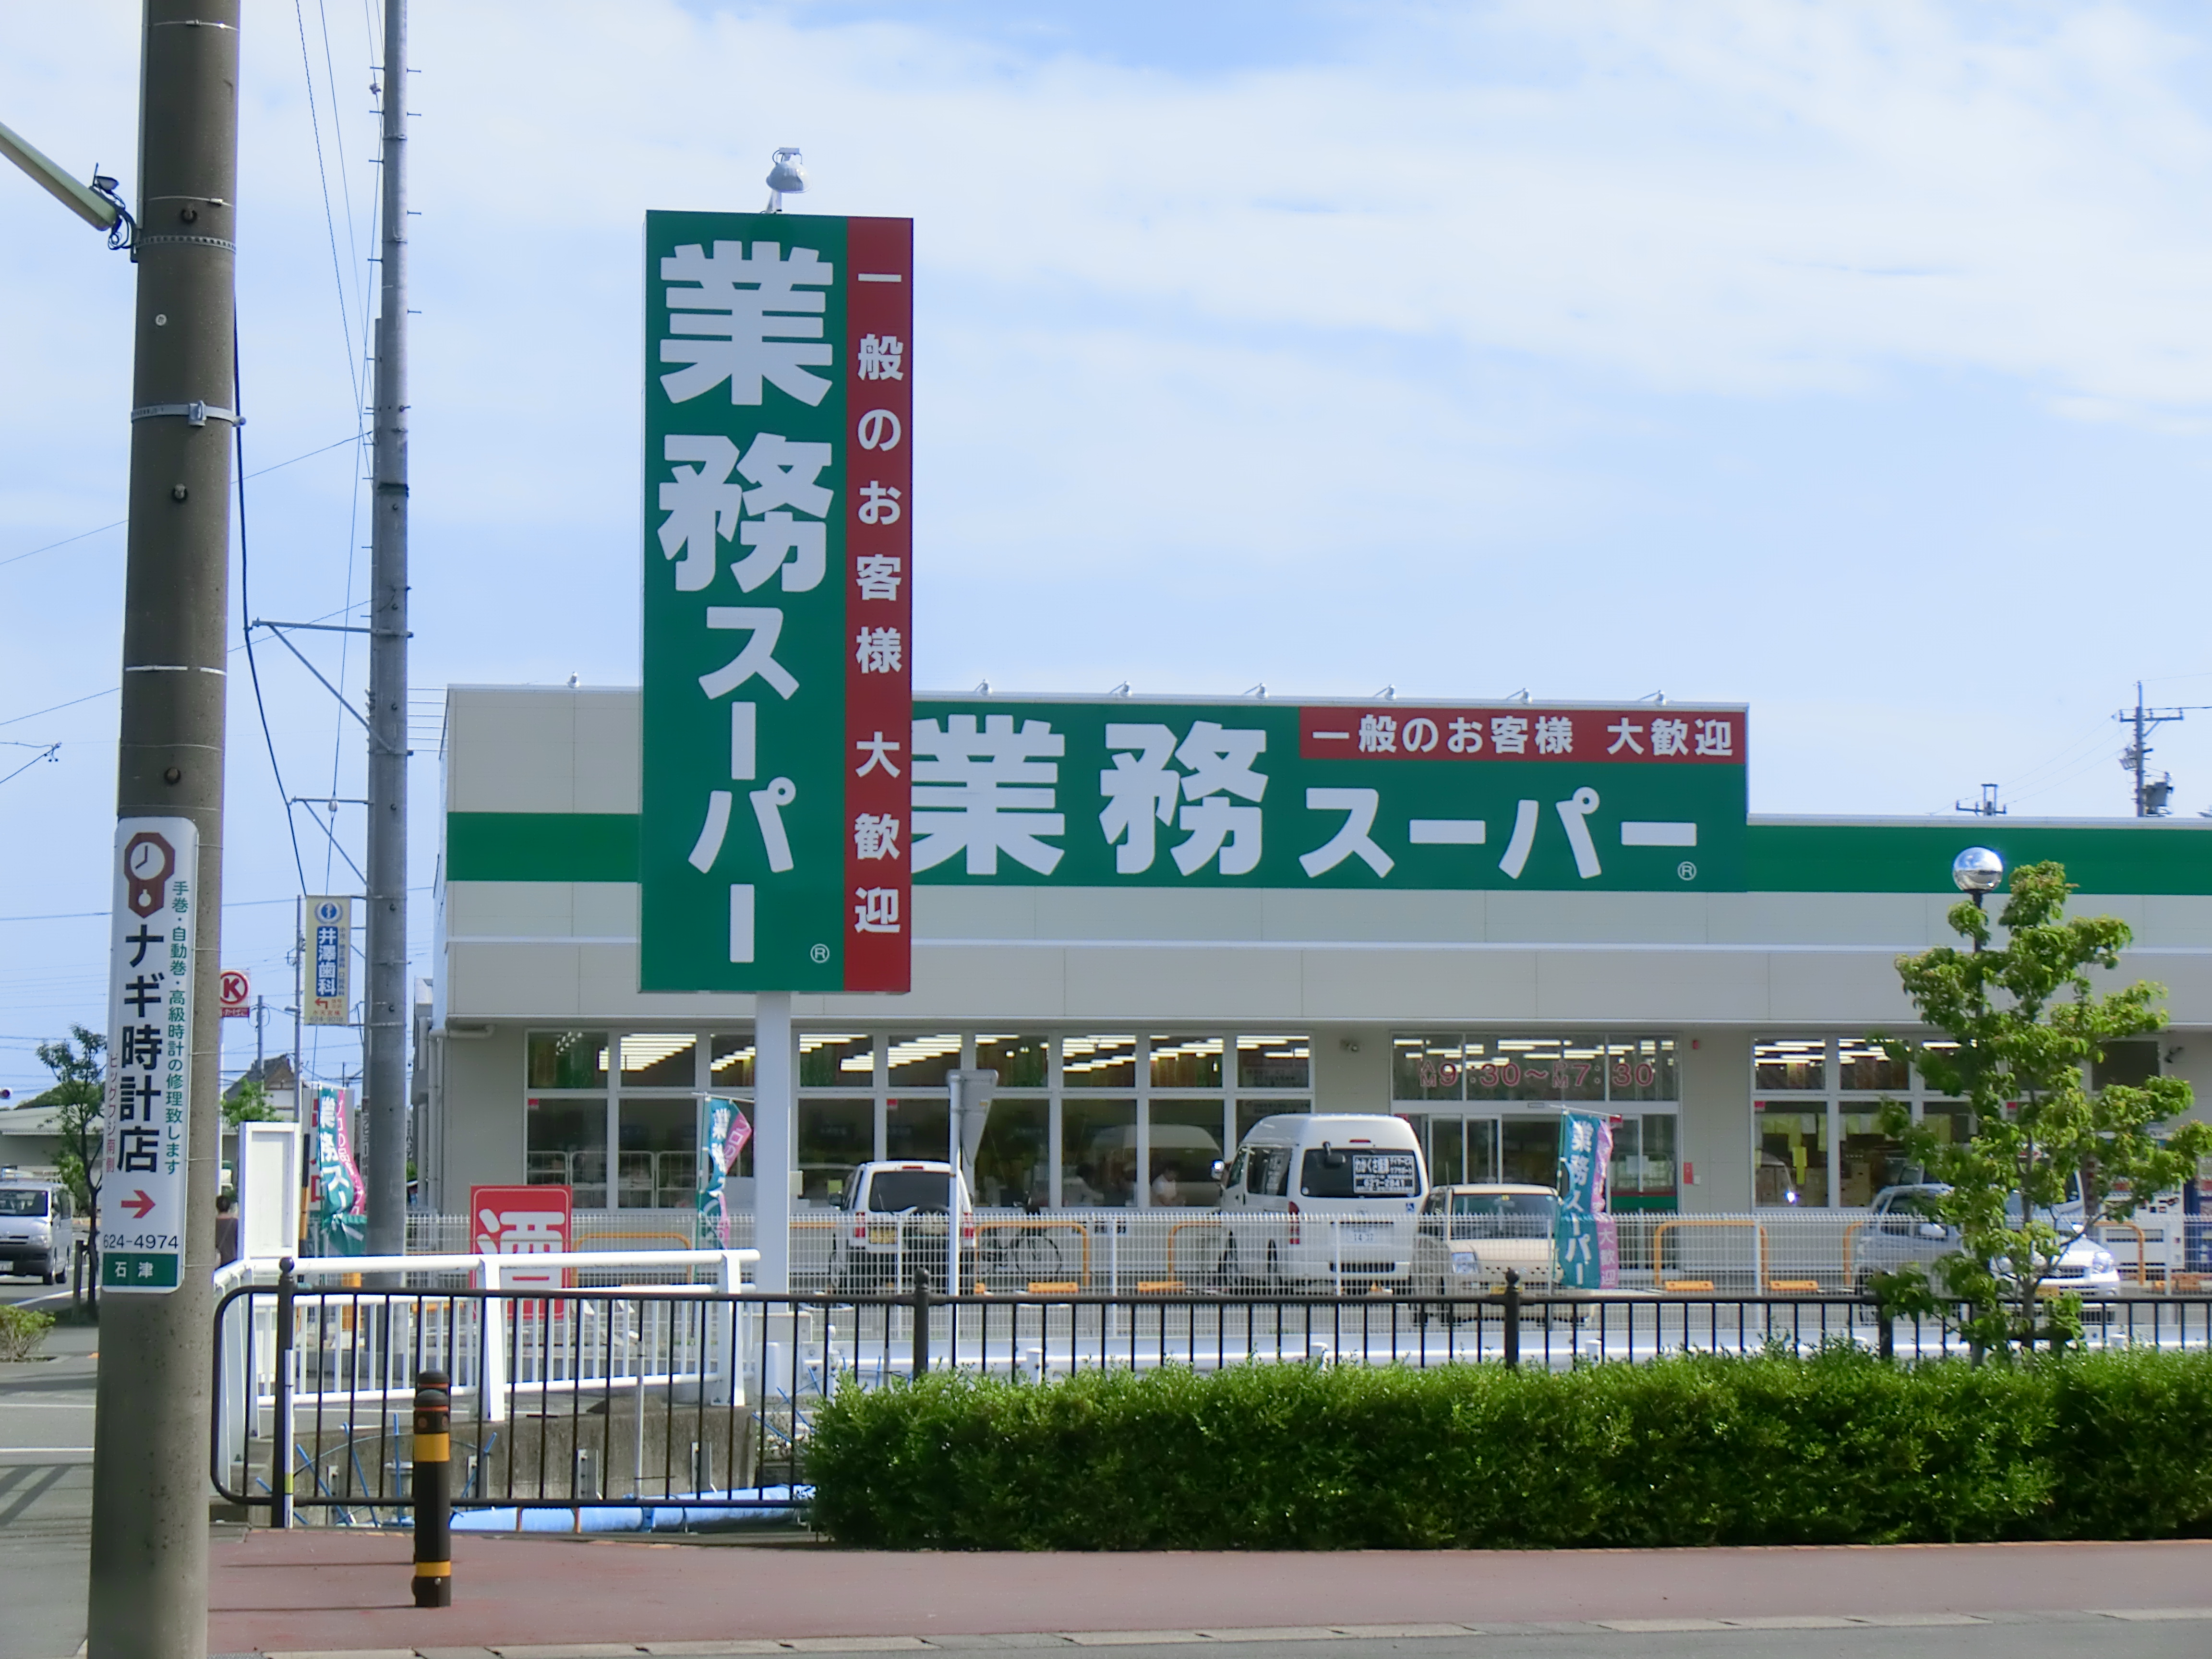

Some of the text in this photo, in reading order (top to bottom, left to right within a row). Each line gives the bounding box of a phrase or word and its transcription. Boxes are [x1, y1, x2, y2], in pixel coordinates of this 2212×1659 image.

[657, 240, 834, 963] 業務スーパー
[854, 273, 904, 933] 一般のお客様 大歓迎
[1312, 714, 1733, 756] 一般のお客様 大歓迎
[911, 714, 1697, 879] 業務スーパー
[318, 927, 337, 996] 井澤歯科
[117, 924, 165, 1172] ナギ時計店
[103, 1234, 179, 1249] 624-4974
[115, 1261, 153, 1278] 石津
